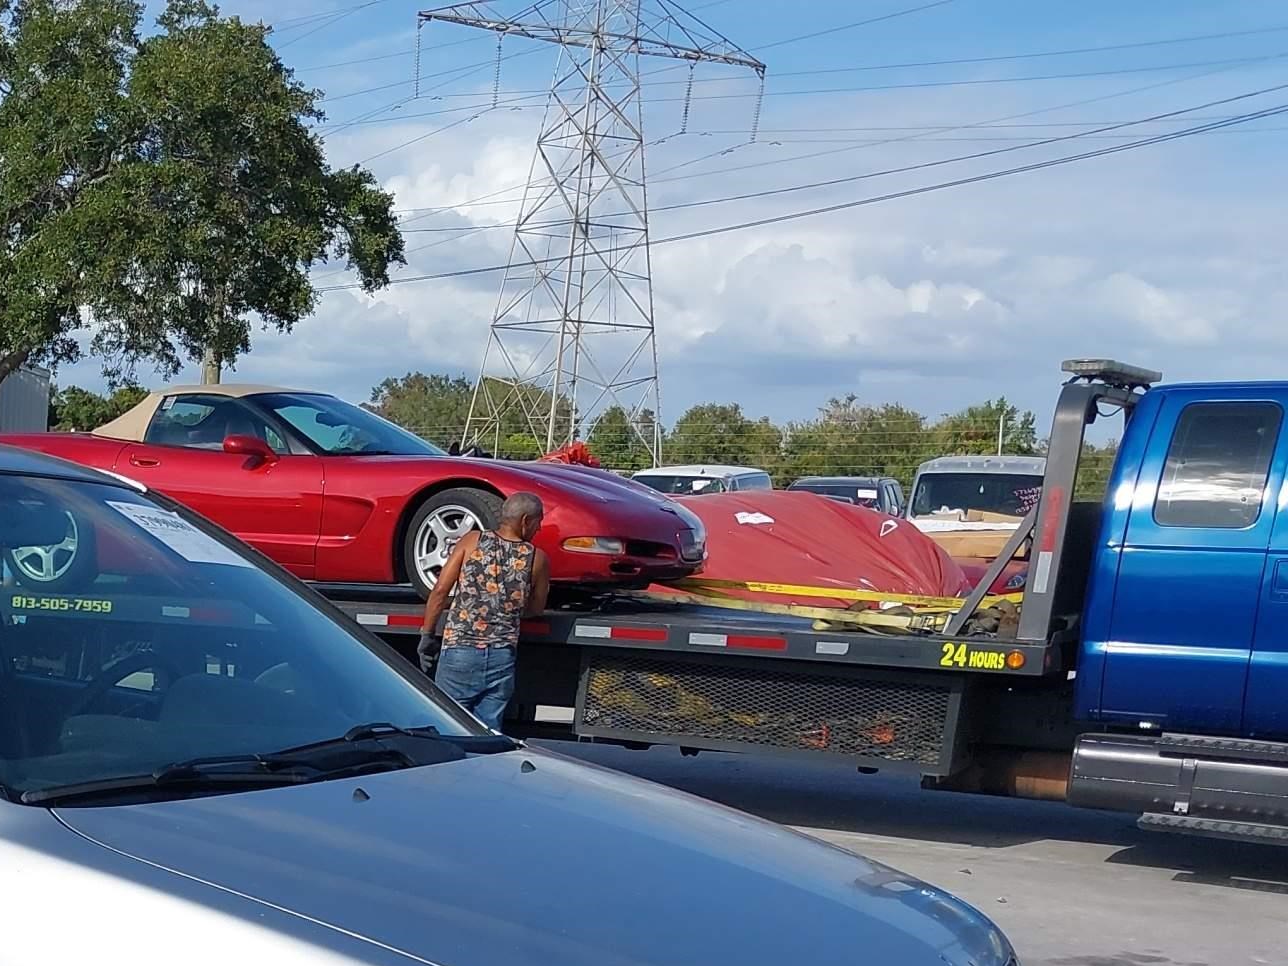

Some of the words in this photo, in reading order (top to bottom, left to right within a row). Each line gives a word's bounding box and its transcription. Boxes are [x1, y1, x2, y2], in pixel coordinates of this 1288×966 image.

[12, 596, 112, 613] 813-505-7959
[940, 642, 967, 668] 24
[968, 650, 1006, 670] HOURS
